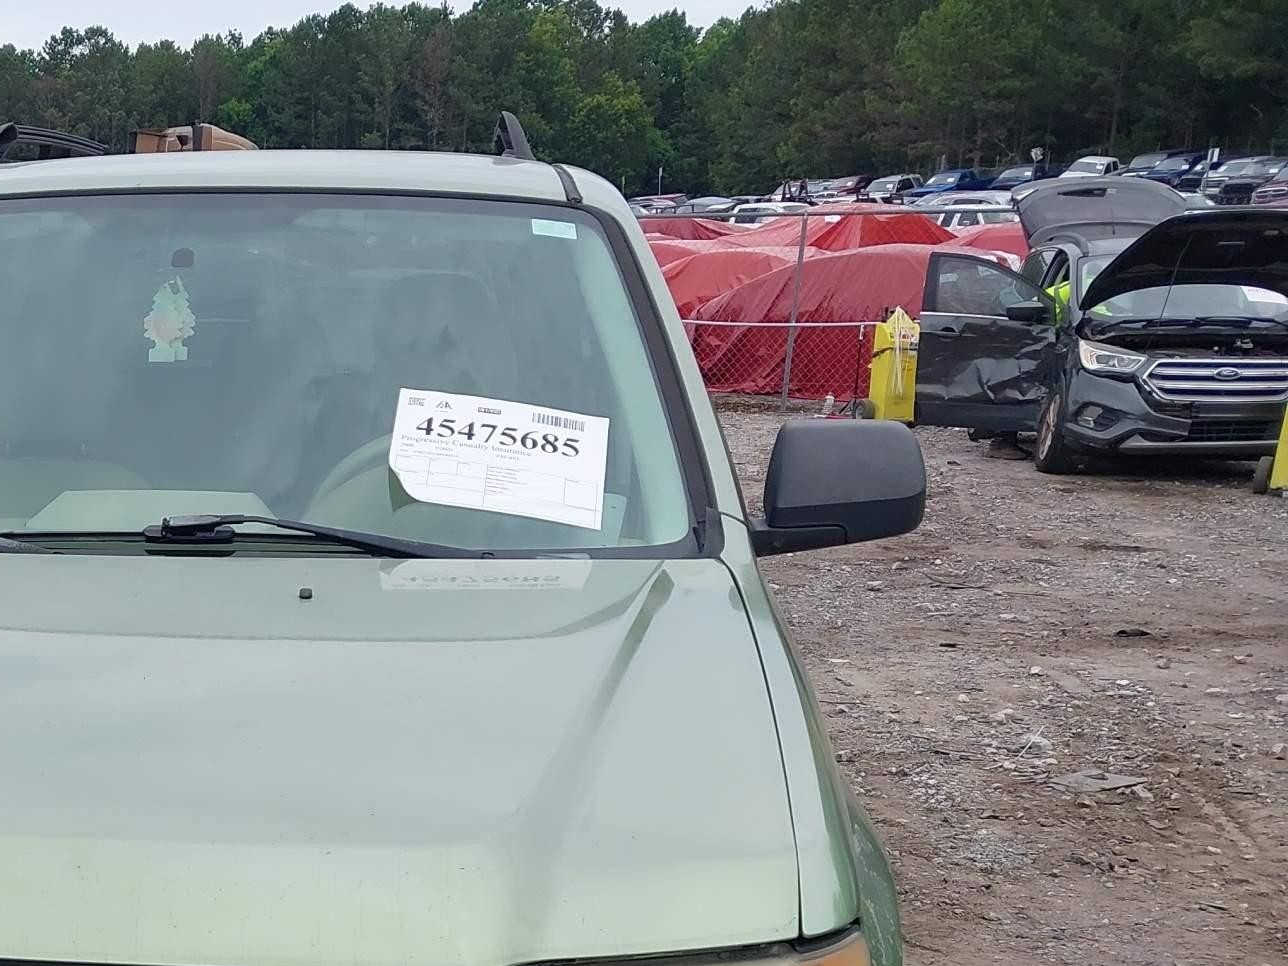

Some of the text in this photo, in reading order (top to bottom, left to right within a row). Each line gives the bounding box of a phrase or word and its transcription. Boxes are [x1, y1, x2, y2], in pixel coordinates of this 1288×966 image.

[401, 434, 451, 446] Progressive
[453, 439, 488, 451] Casualty
[492, 445, 532, 457] Insurance
[416, 416, 580, 457] 45475685
